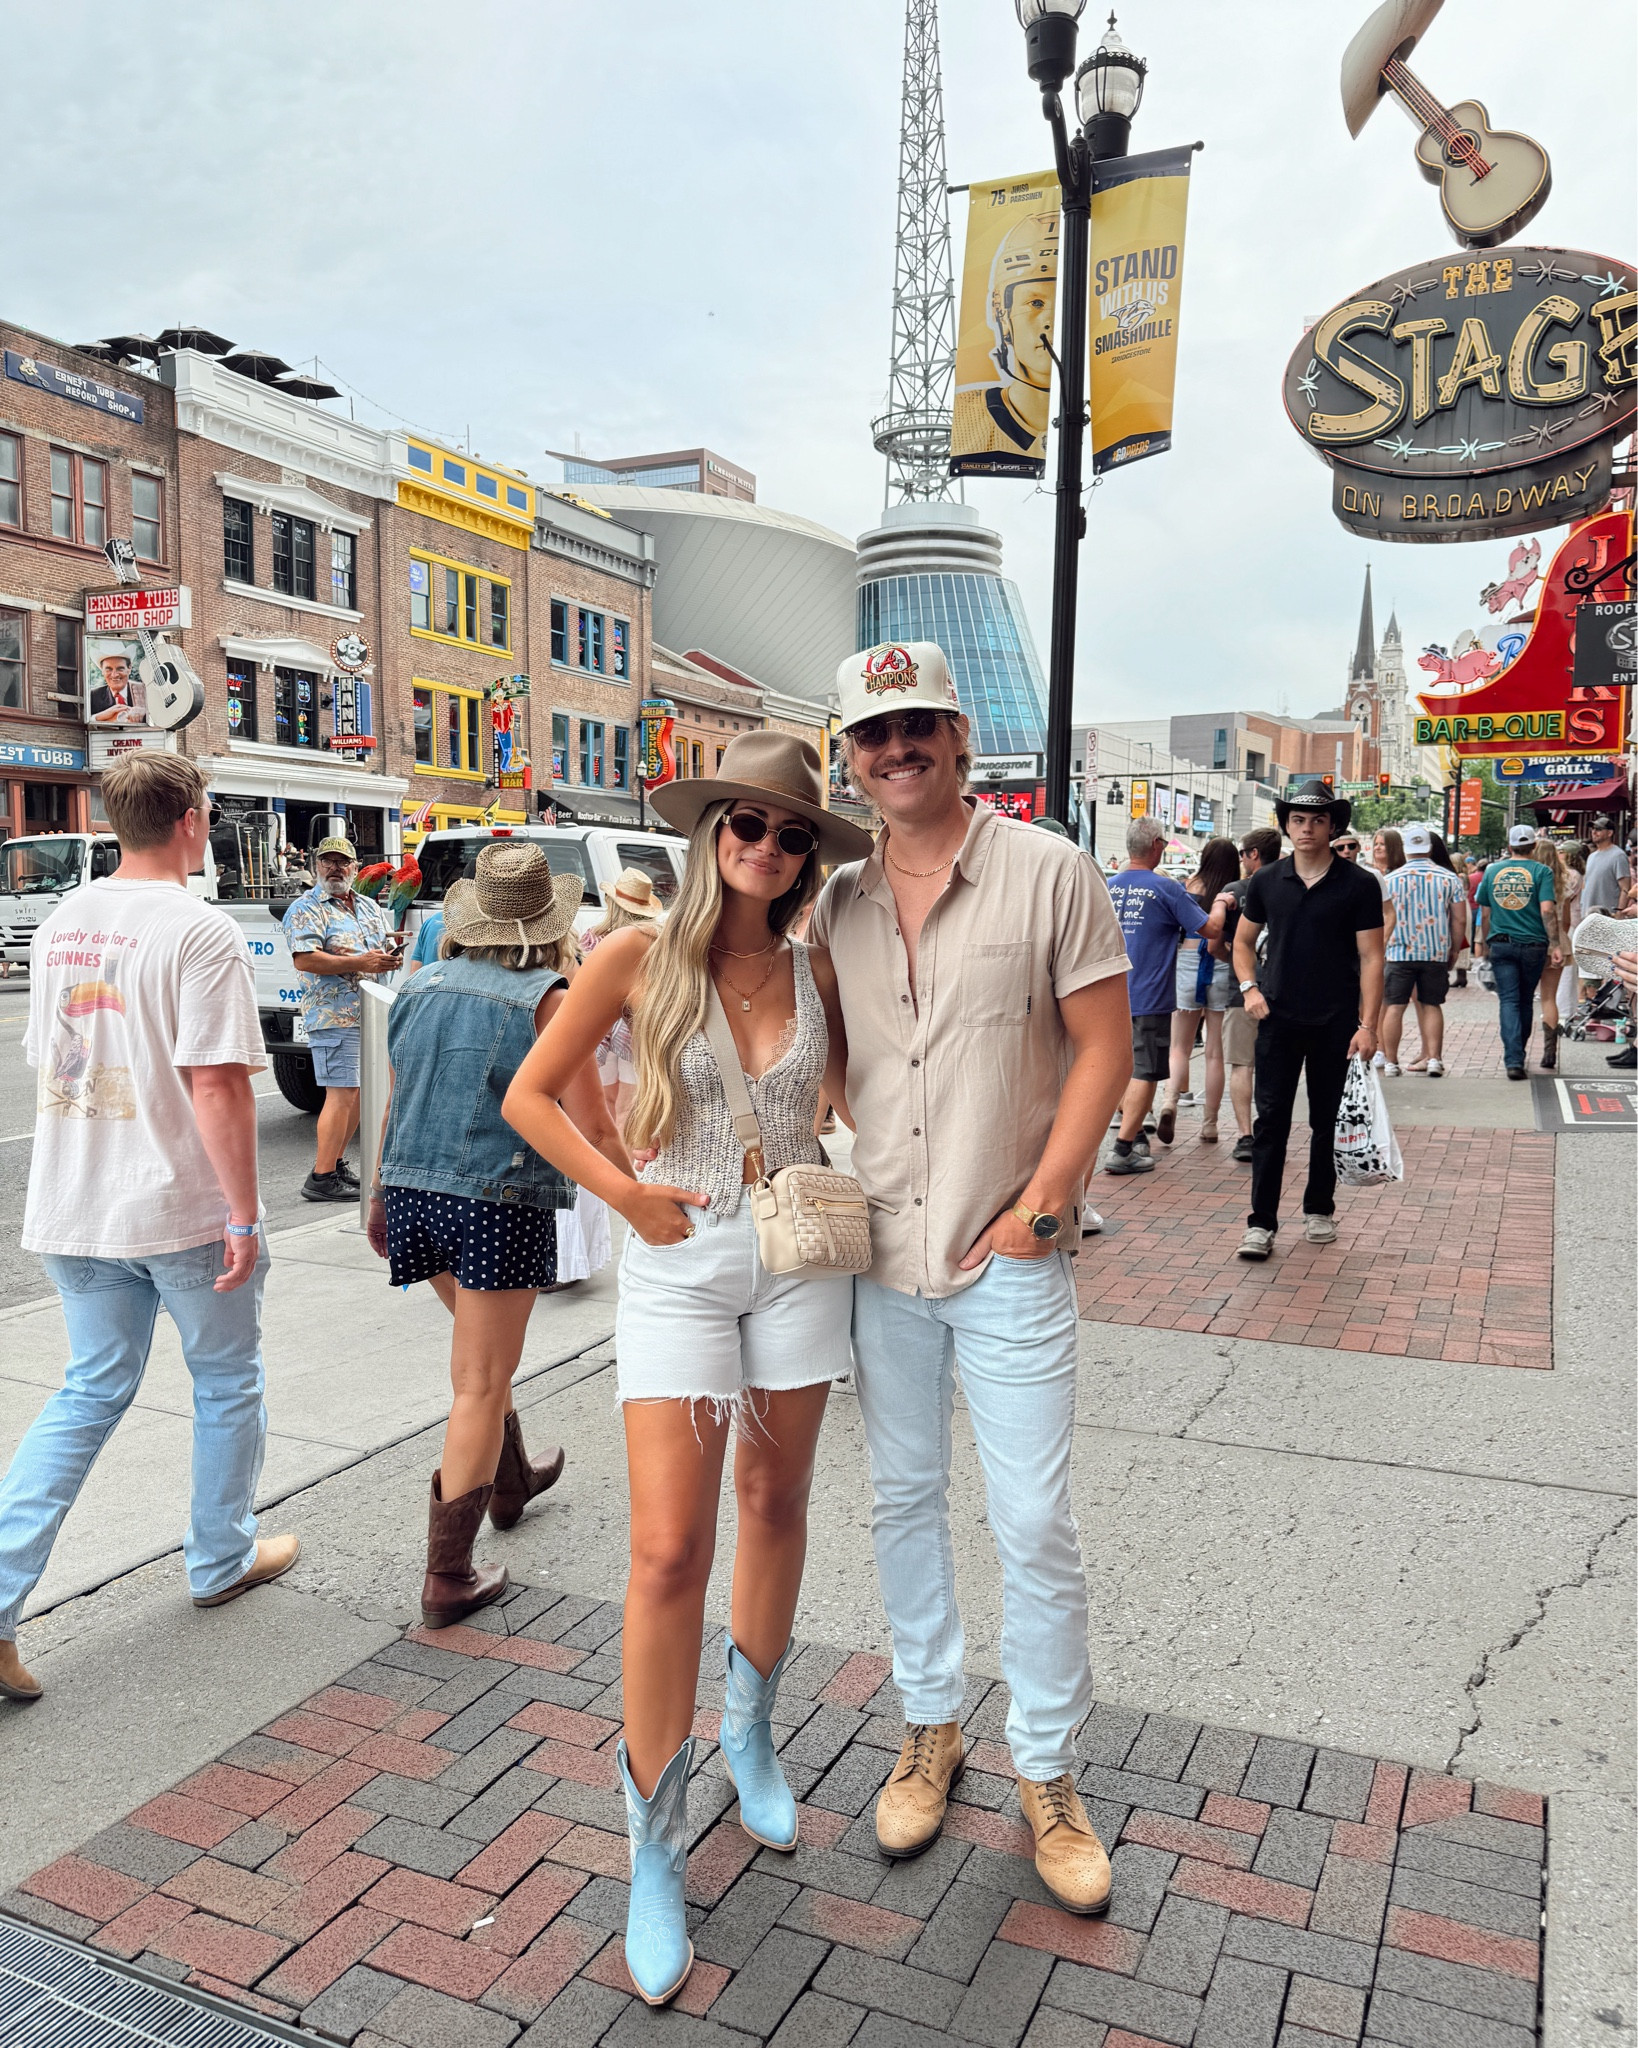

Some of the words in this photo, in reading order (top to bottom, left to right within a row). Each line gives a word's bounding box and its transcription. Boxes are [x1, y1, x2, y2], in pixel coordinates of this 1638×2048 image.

[991, 188, 1006, 207] 75
[1095, 244, 1178, 297] STAND
[1442, 258, 1515, 300] THE
[1100, 281, 1143, 321] WITH
[1146, 281, 1169, 306] US
[1094, 318, 1173, 356] SMASHVILLE
[1307, 290, 1638, 443] STAGE
[54, 369, 88, 390] ERNEST
[95, 385, 115, 400] TUBB
[65, 385, 98, 404] RECORD
[1341, 485, 1382, 518] ON
[1402, 463, 1597, 519] BROADWAY
[88, 592, 139, 613] ERNEST
[144, 588, 179, 607] TUBB
[95, 612, 139, 630] RECORD
[143, 609, 173, 627] SHOP
[865, 671, 918, 694] CHAMPIONS
[341, 677, 354, 735] HANK
[1417, 713, 1562, 742] BAR-B-QUE
[112, 739, 143, 747] CREATIVE
[331, 737, 363, 745] WILLIAMS
[648, 719, 657, 777] MUSHROOM
[31, 748, 74, 766] TUBB
[984, 770, 1009, 778] ARENA
[1544, 763, 1594, 776] GRILL
[557, 810, 573, 819] Beer
[1110, 884, 1126, 898] dog
[1128, 884, 1157, 900] beers,
[1493, 884, 1533, 892] ARIAT
[1126, 897, 1145, 911] only
[50, 928, 88, 945] Lovely
[91, 930, 109, 947] day
[110, 930, 128, 946] for
[129, 938, 138, 949] a
[46, 950, 102, 968] GUINNES
